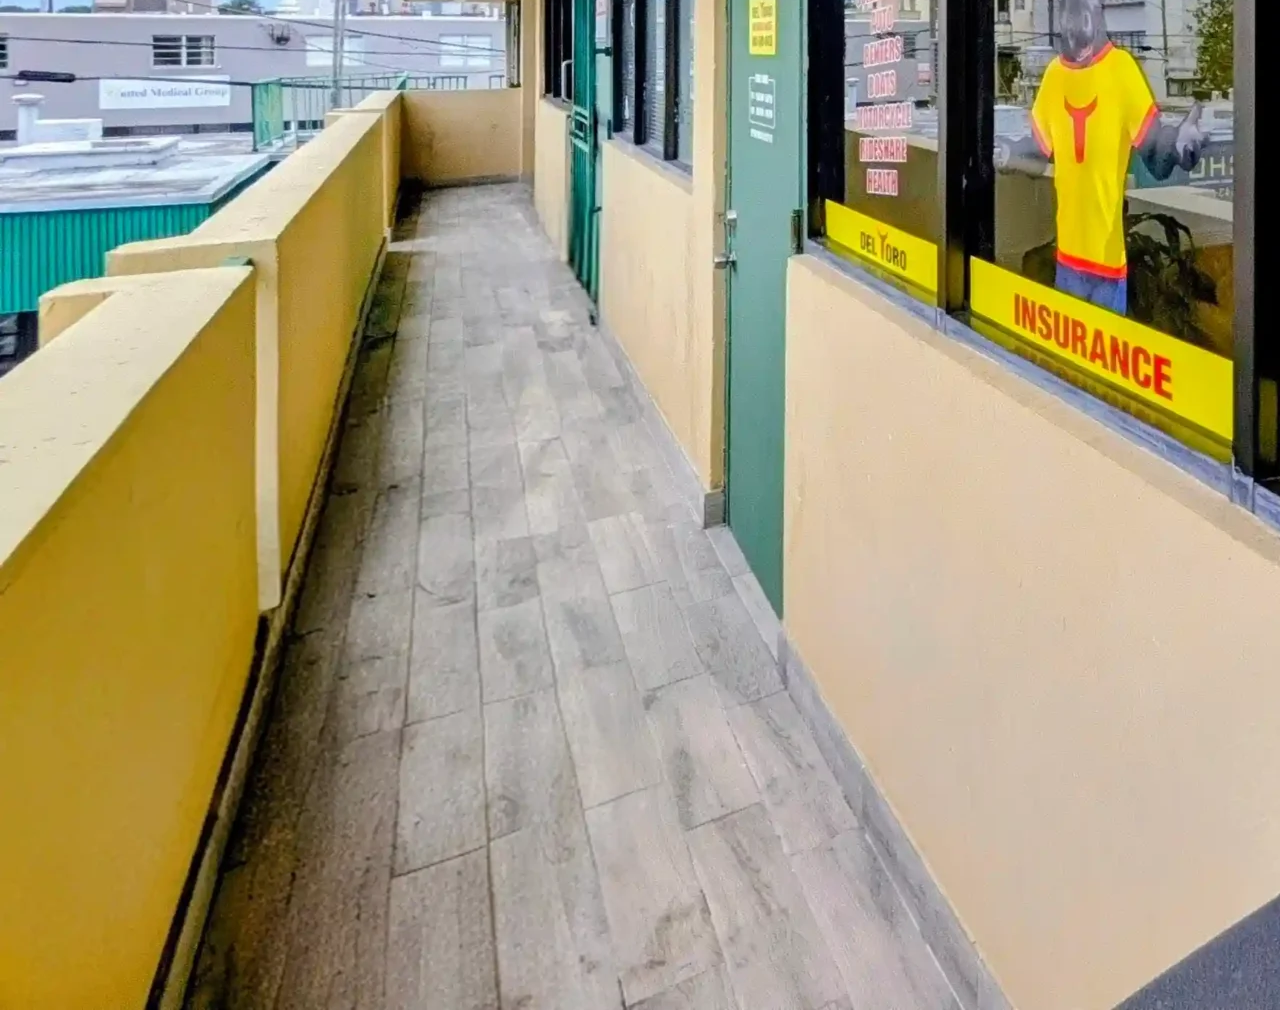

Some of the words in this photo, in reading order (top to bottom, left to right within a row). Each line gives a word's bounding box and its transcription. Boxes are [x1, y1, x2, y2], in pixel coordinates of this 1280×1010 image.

[863, 36, 901, 67] RENTERS
[860, 137, 907, 162] RIDESHARE
[867, 169, 898, 196] HEALTH
[860, 231, 877, 256] DEL
[1013, 293, 1173, 401] INSURANCE
